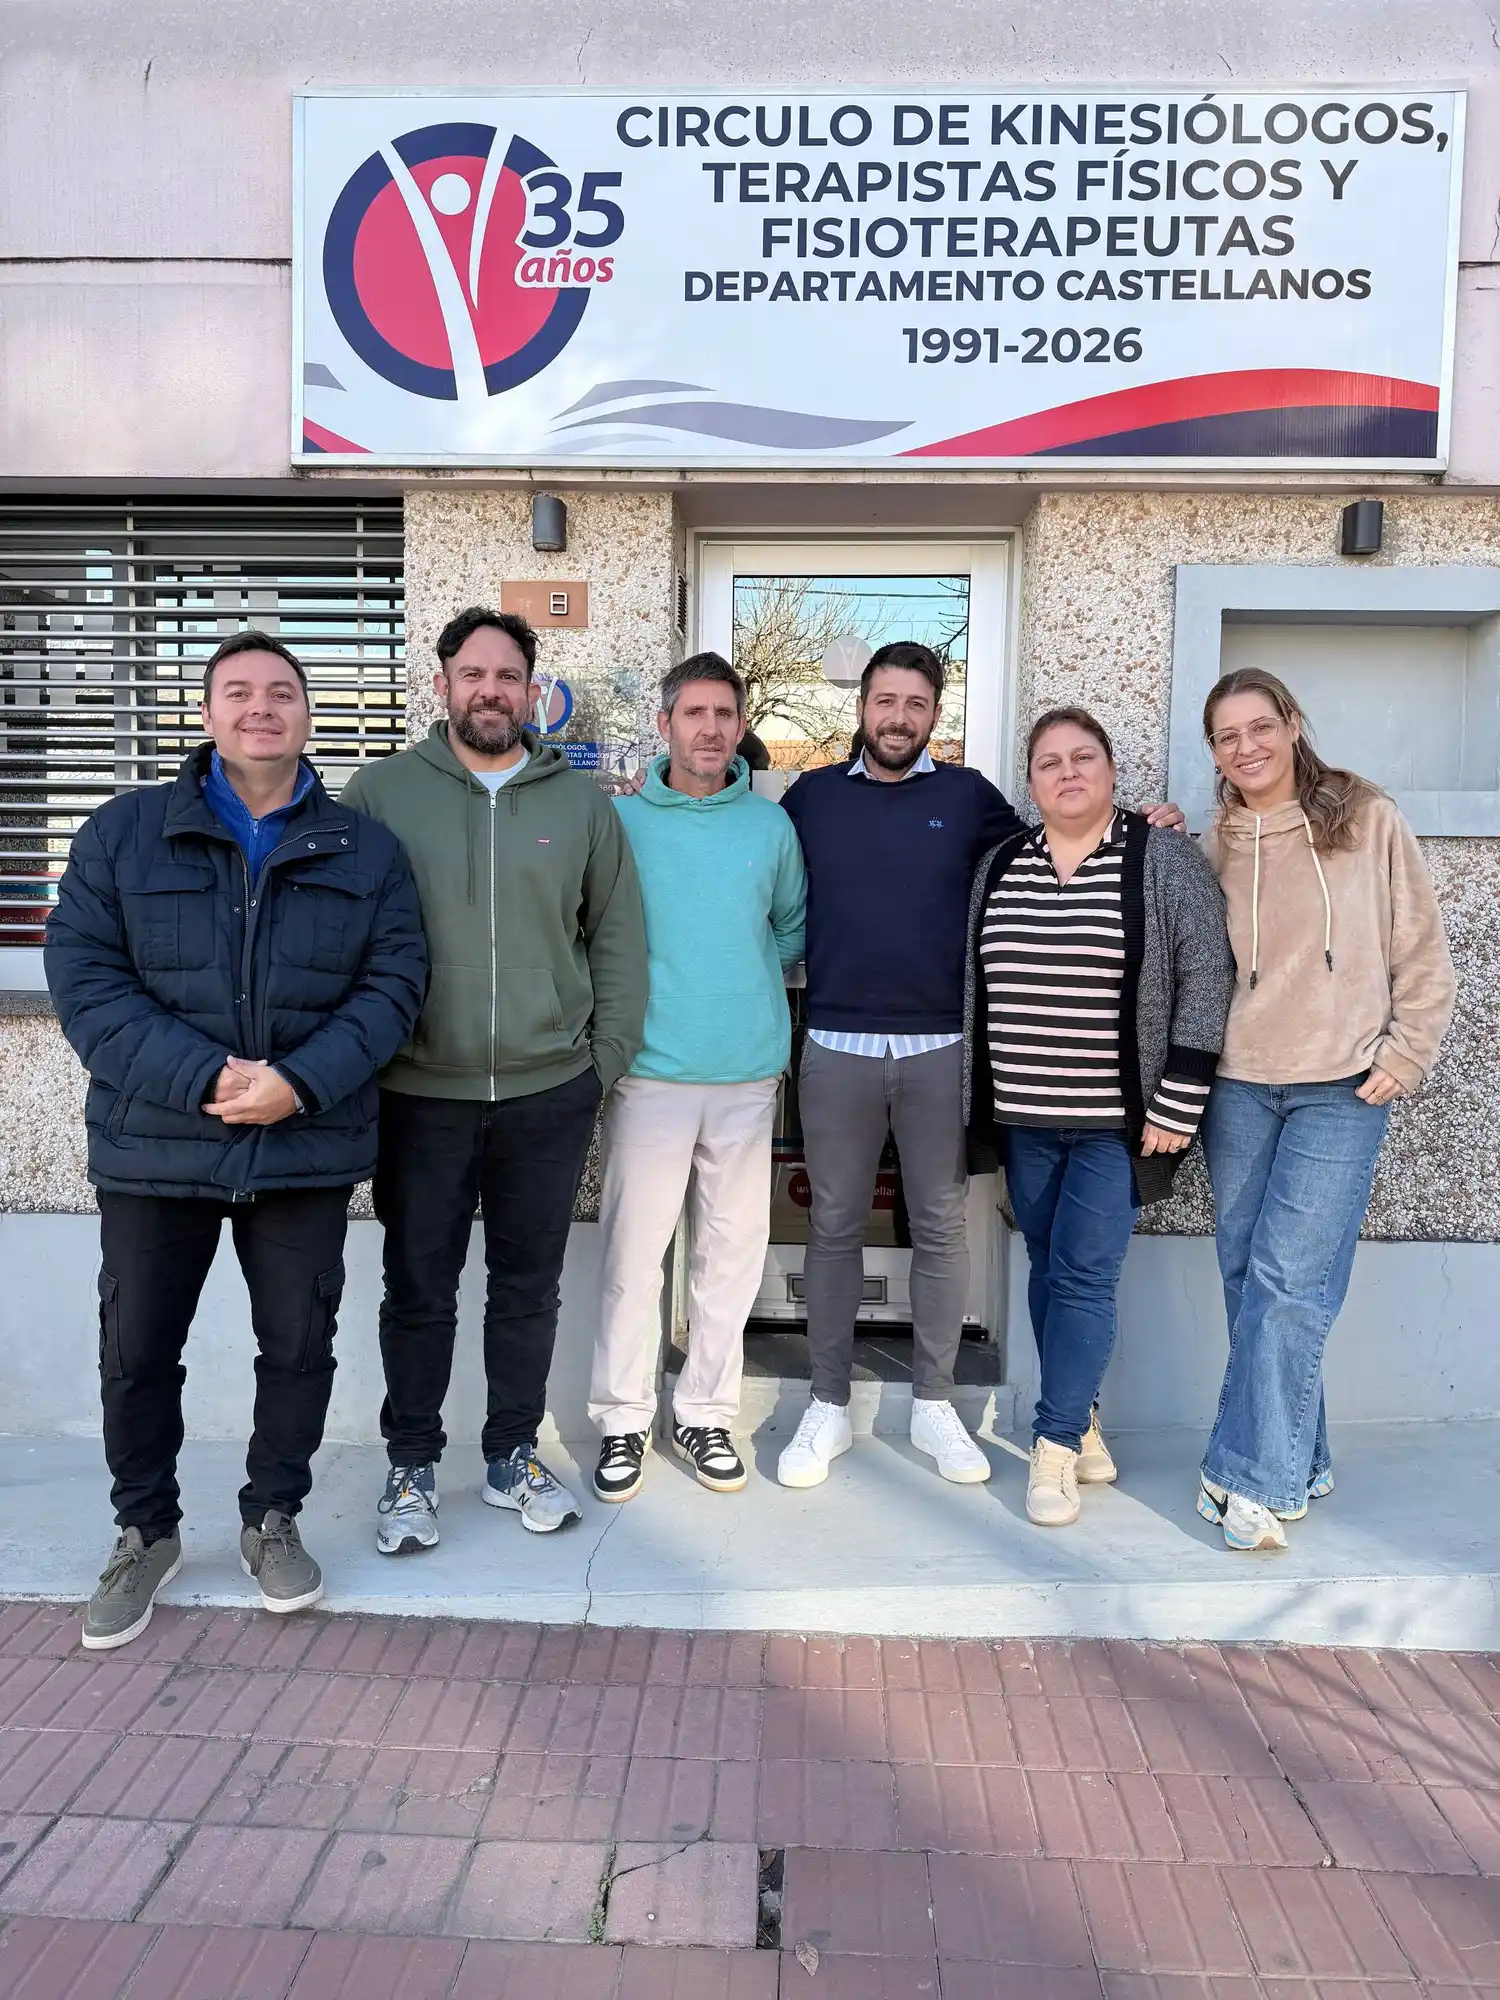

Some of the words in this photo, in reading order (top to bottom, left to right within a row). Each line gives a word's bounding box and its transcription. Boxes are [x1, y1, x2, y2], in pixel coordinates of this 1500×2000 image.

[616, 105, 873, 148] CIRCULO
[893, 104, 970, 146] DE
[990, 93, 1449, 154] KINESIÓLOGOS,
[701, 160, 1057, 203] TERAPISTAS
[1076, 148, 1303, 202] FÍSICOS
[1319, 159, 1359, 200] Y
[521, 171, 625, 249] 35
[762, 214, 1295, 259] FISIOTERAPEUTAS
[520, 248, 615, 283] años
[684, 269, 1045, 302] DEPARTAMENTO
[1056, 268, 1372, 302] CASTELLANOS
[902, 326, 1143, 364] 1991-2026
